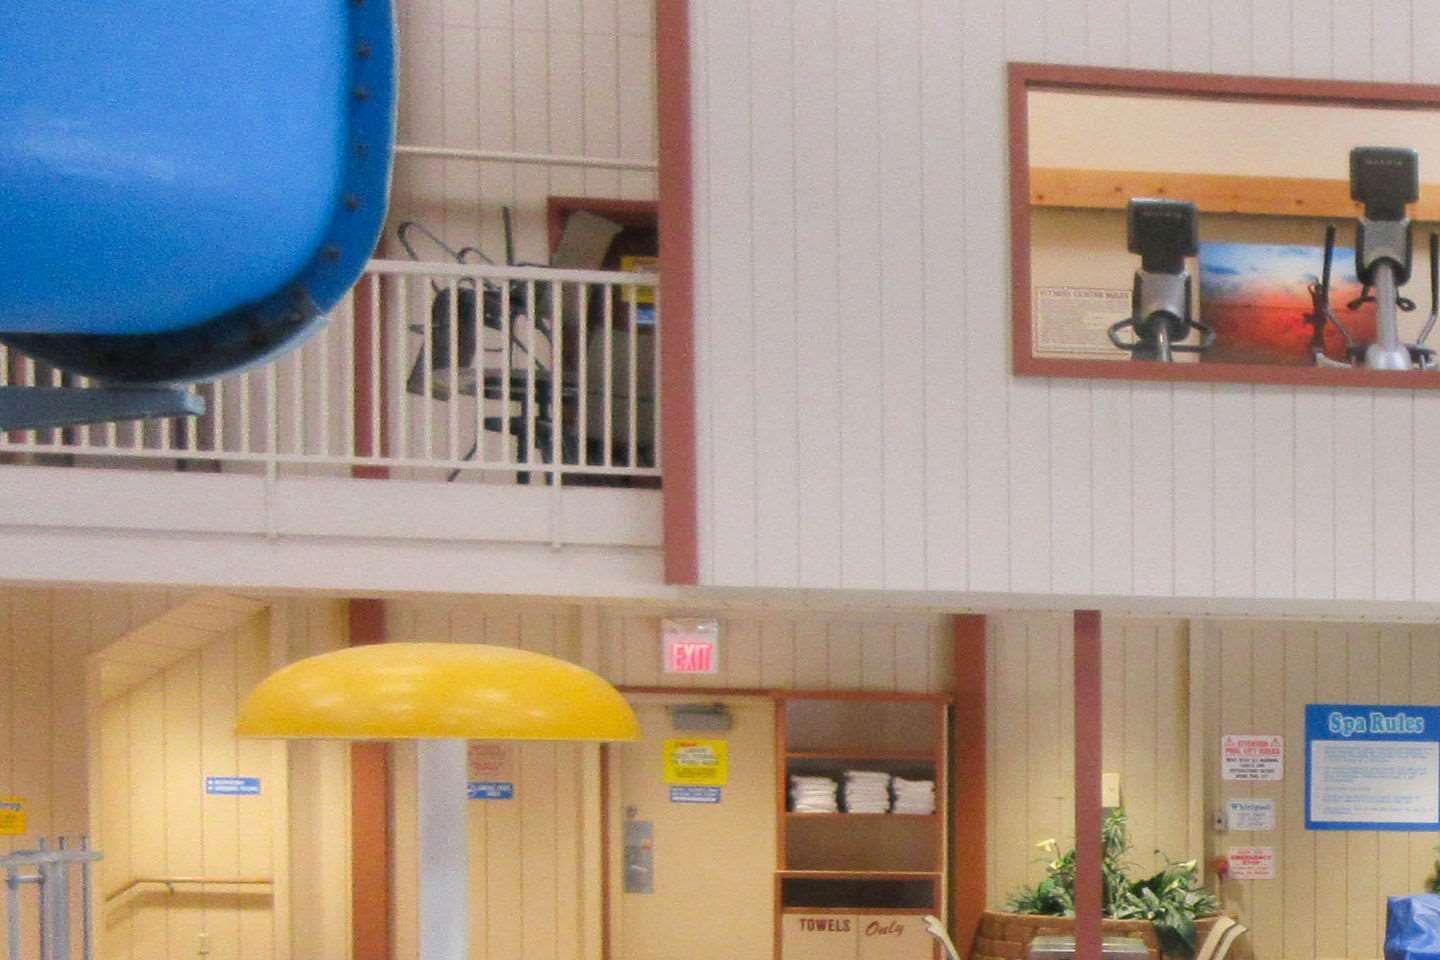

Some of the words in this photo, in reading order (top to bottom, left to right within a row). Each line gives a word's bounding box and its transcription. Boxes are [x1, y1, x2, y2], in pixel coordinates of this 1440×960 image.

[673, 643, 713, 671] EXIT
[1329, 712, 1367, 737] Spa
[1369, 712, 1424, 734] Rules
[799, 919, 851, 932] TOWELS
[865, 920, 905, 936] Only
